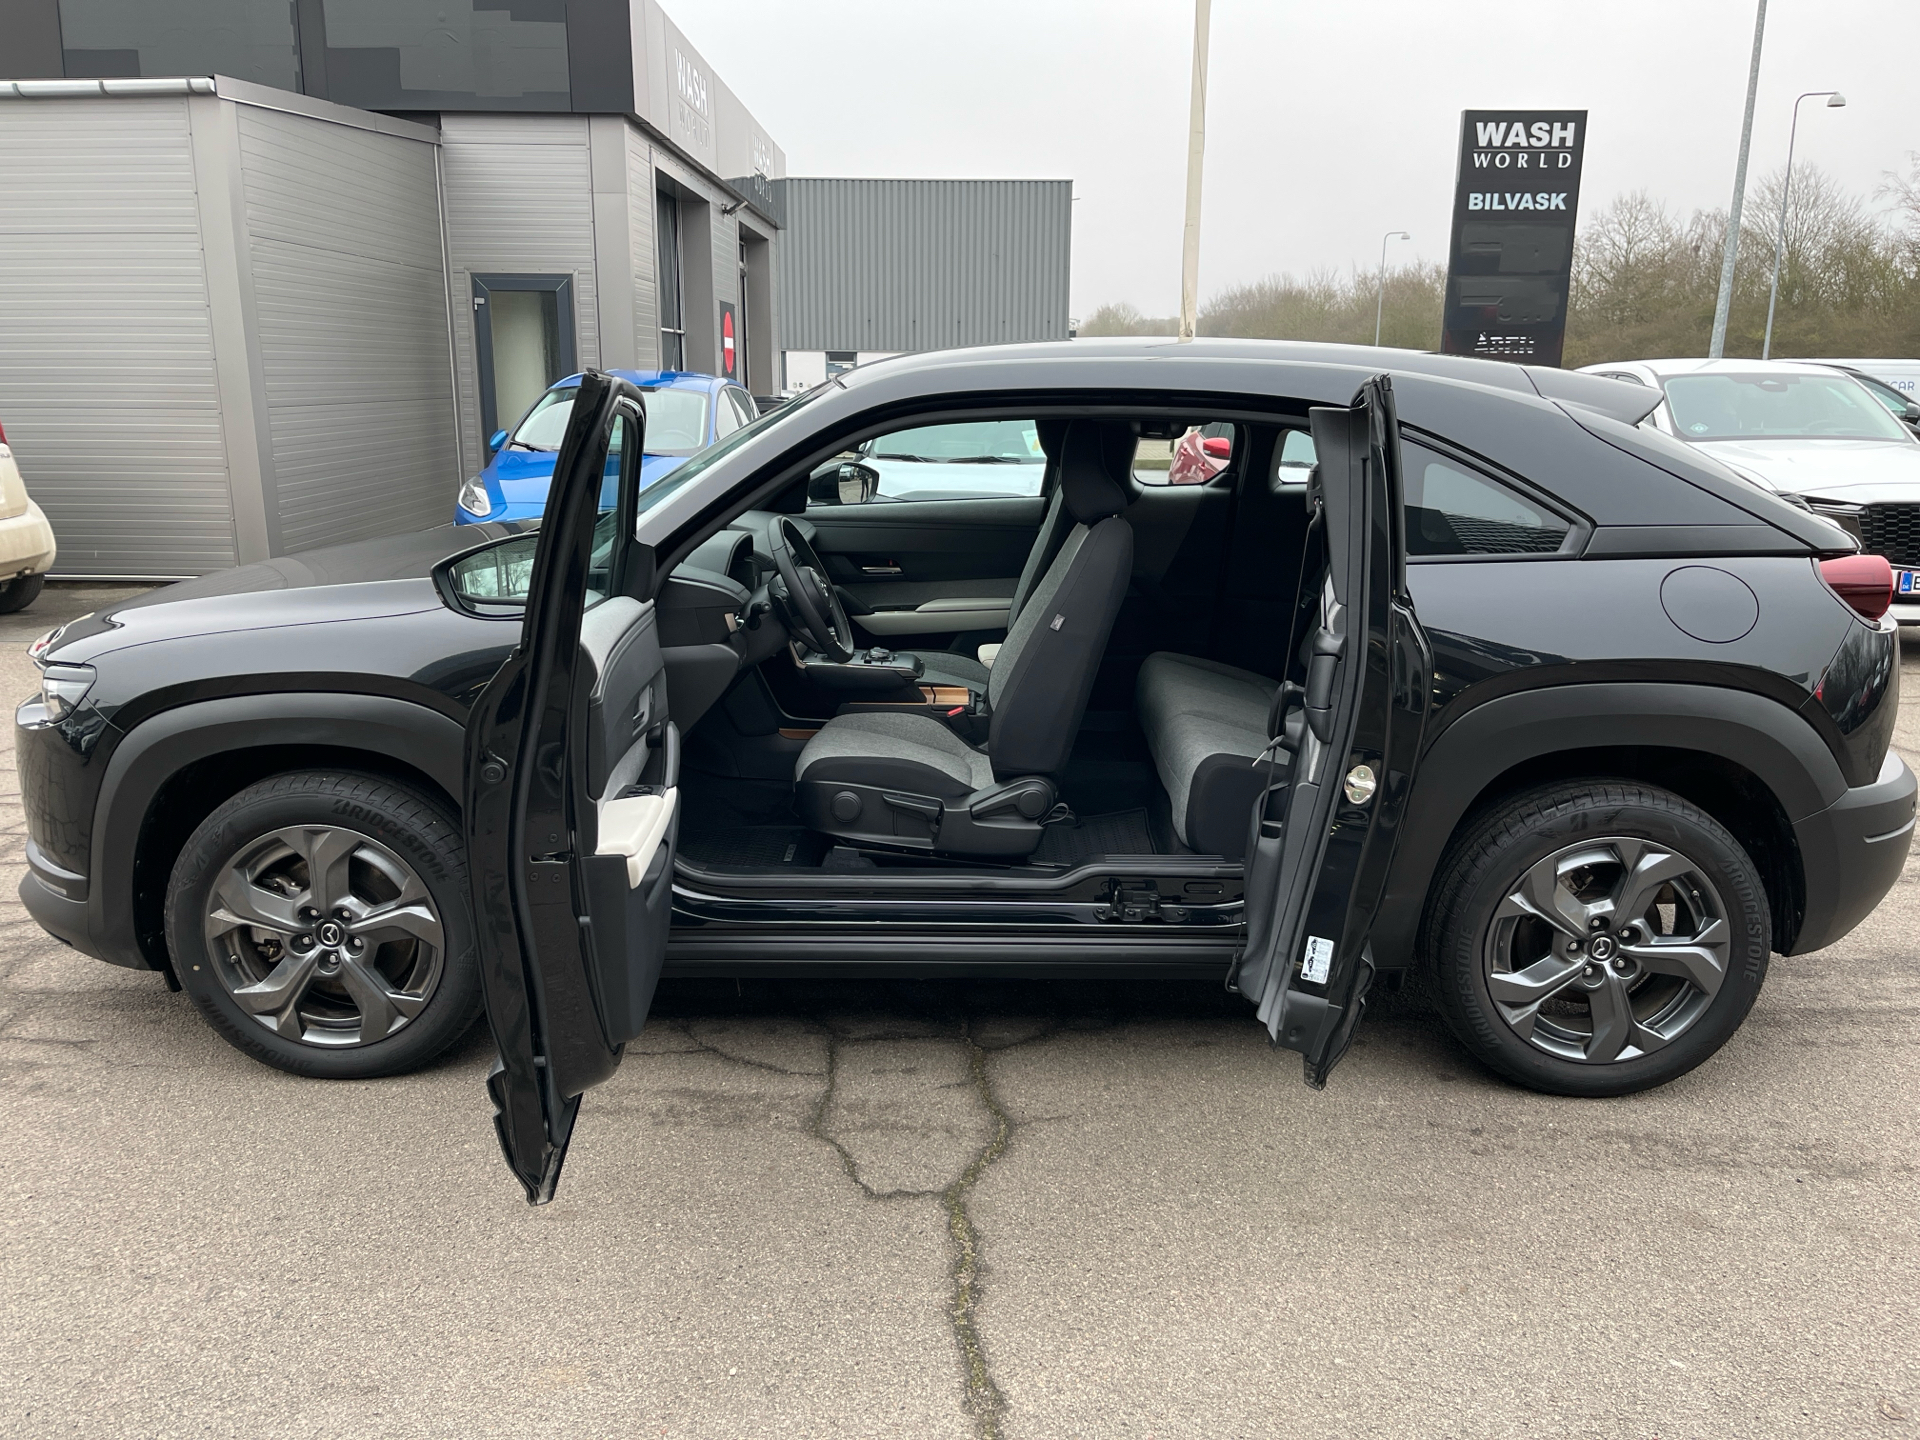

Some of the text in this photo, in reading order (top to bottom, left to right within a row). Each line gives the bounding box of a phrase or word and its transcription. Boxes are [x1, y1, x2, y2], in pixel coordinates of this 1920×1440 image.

[674, 48, 709, 117] WASH
[678, 102, 711, 150] WORLD
[1475, 121, 1576, 147] WASH
[1472, 153, 1572, 168] WORLD
[1468, 192, 1568, 210] BILVASK
[331, 798, 449, 884] BRIDGESTONE
[1718, 858, 1763, 983] BRIDGESTONE
[1455, 925, 1503, 1049] BRIDGESTONE
